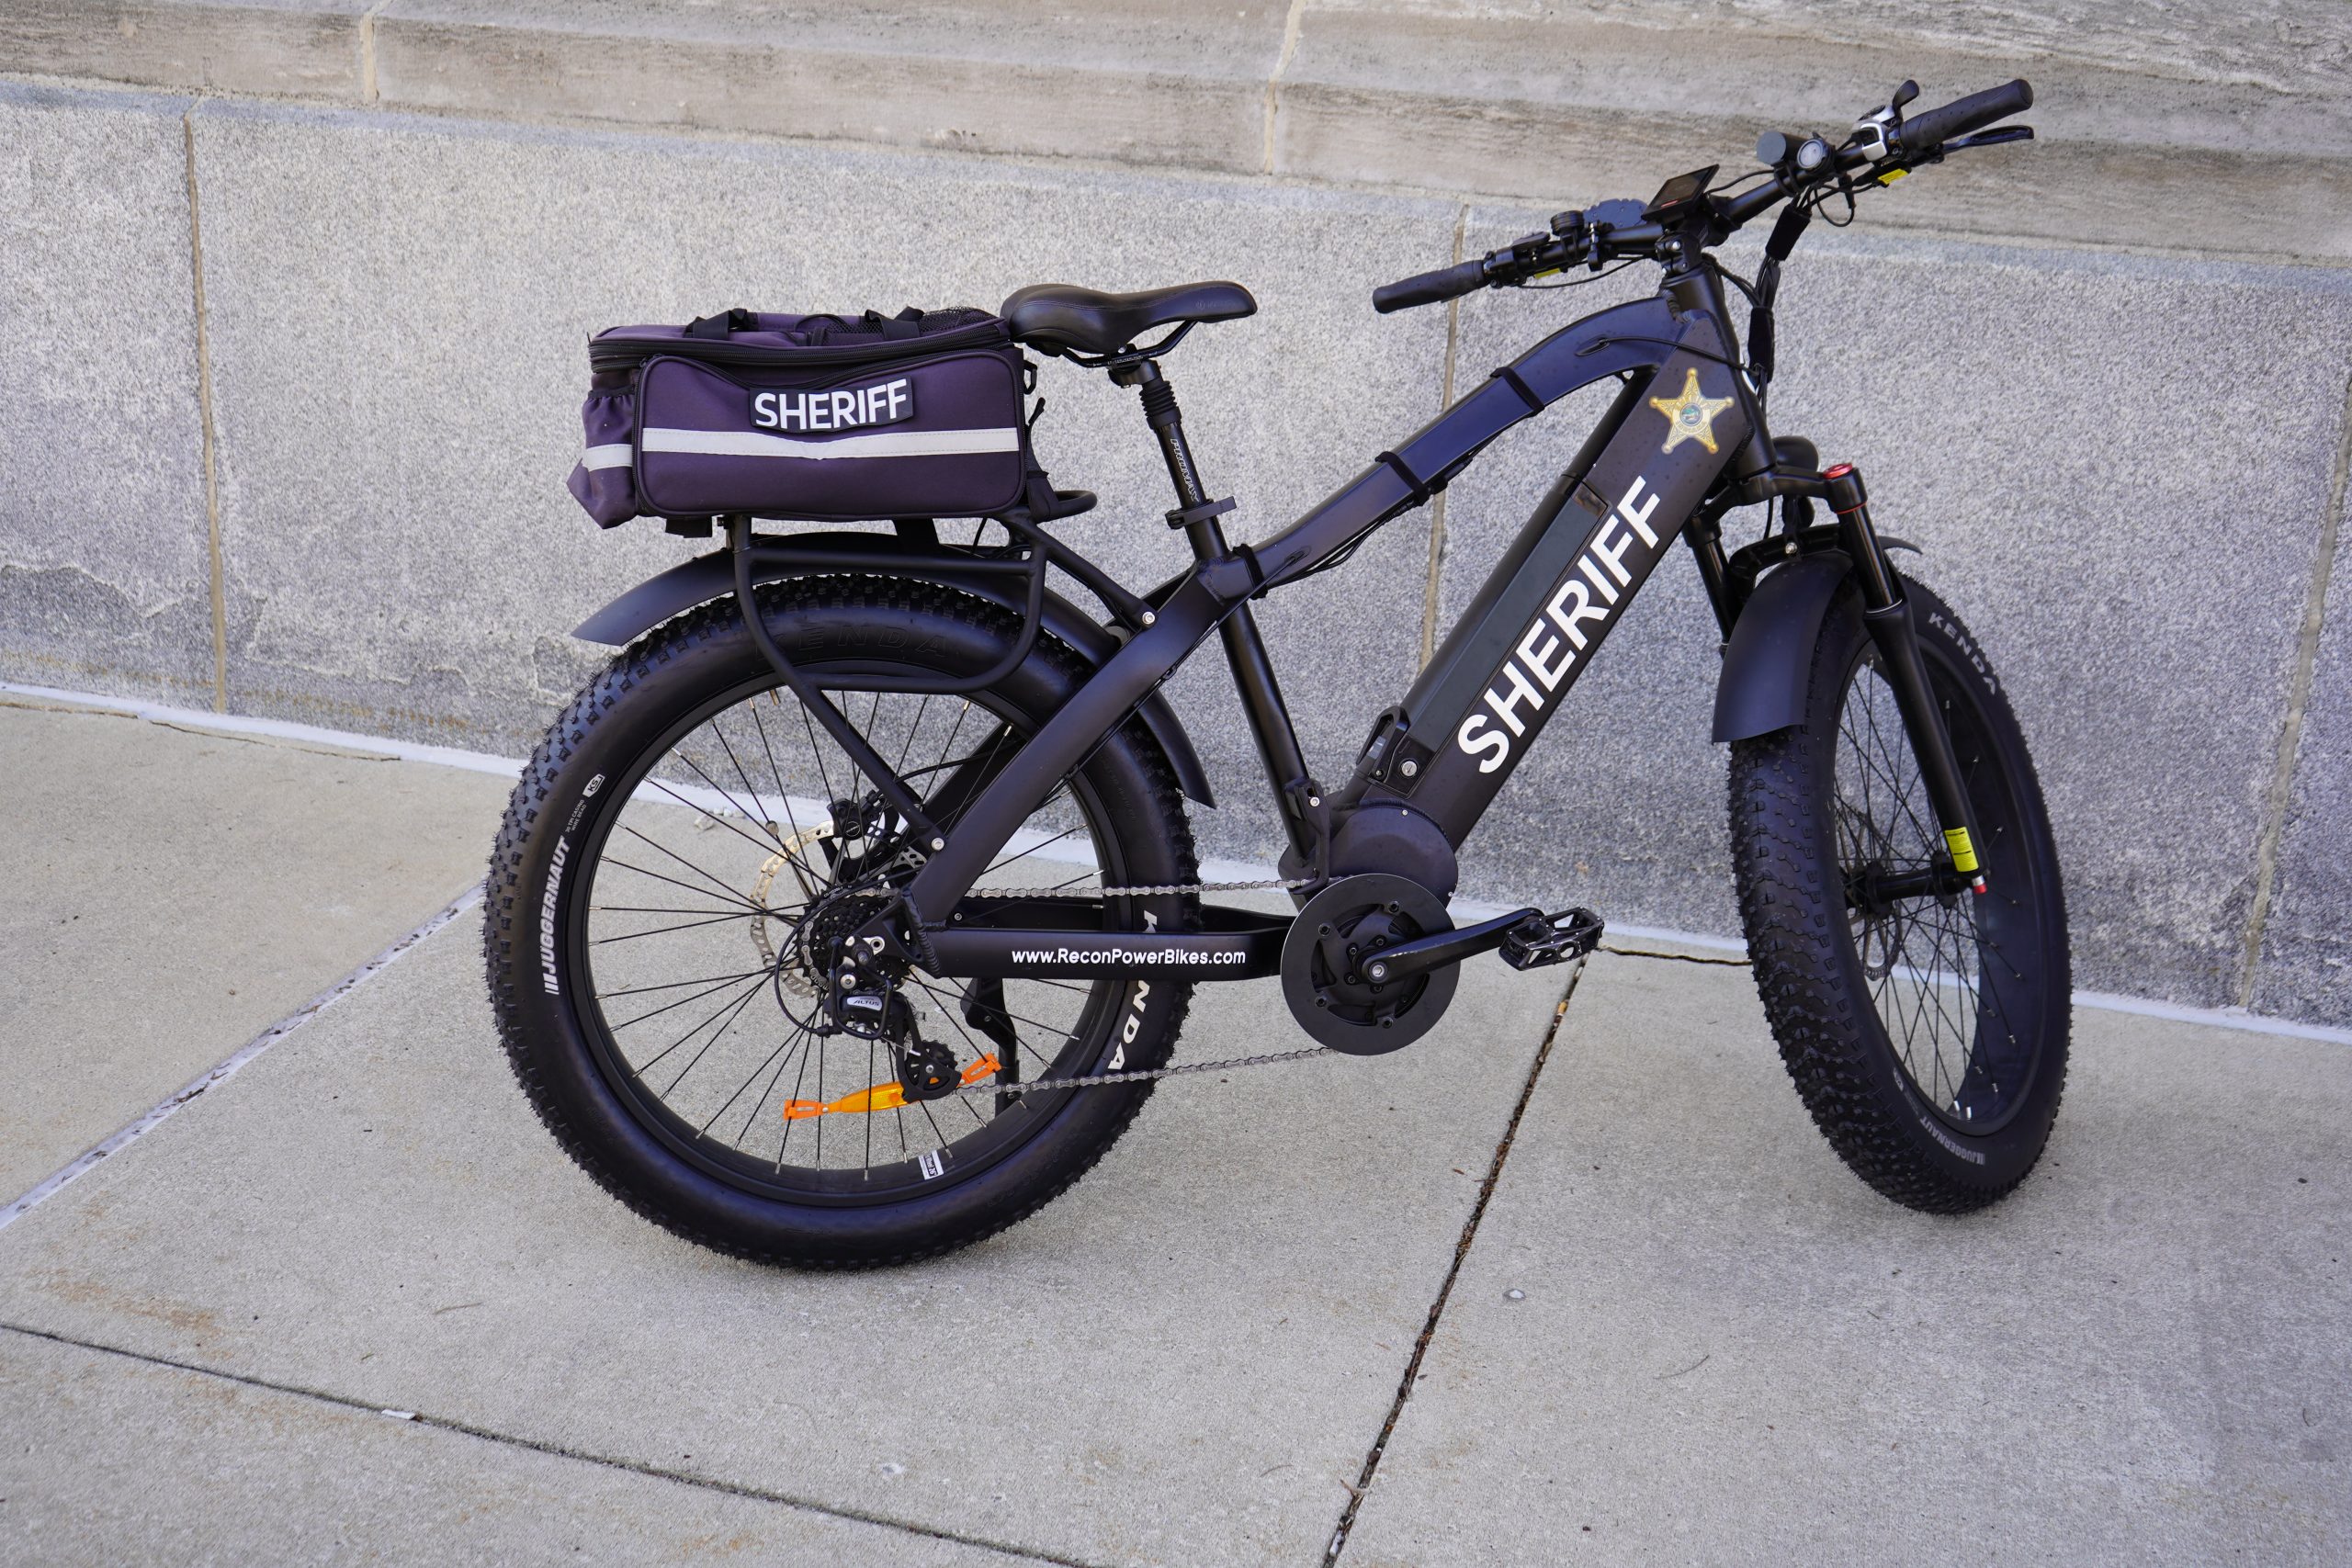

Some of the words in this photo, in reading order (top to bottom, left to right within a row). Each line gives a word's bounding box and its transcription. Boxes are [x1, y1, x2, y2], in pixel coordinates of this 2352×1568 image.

[754, 378, 907, 430] SHERIFF
[1457, 475, 1661, 774] SHERIFF
[1928, 612, 1996, 695] KENDA
[539, 835, 571, 975] JUGGERNAUT
[1012, 948, 1246, 964] www.ReconPowerBikes.com
[1108, 909, 1158, 1070] KNDA
[1919, 1116, 1980, 1165] JUGGERNAUT
